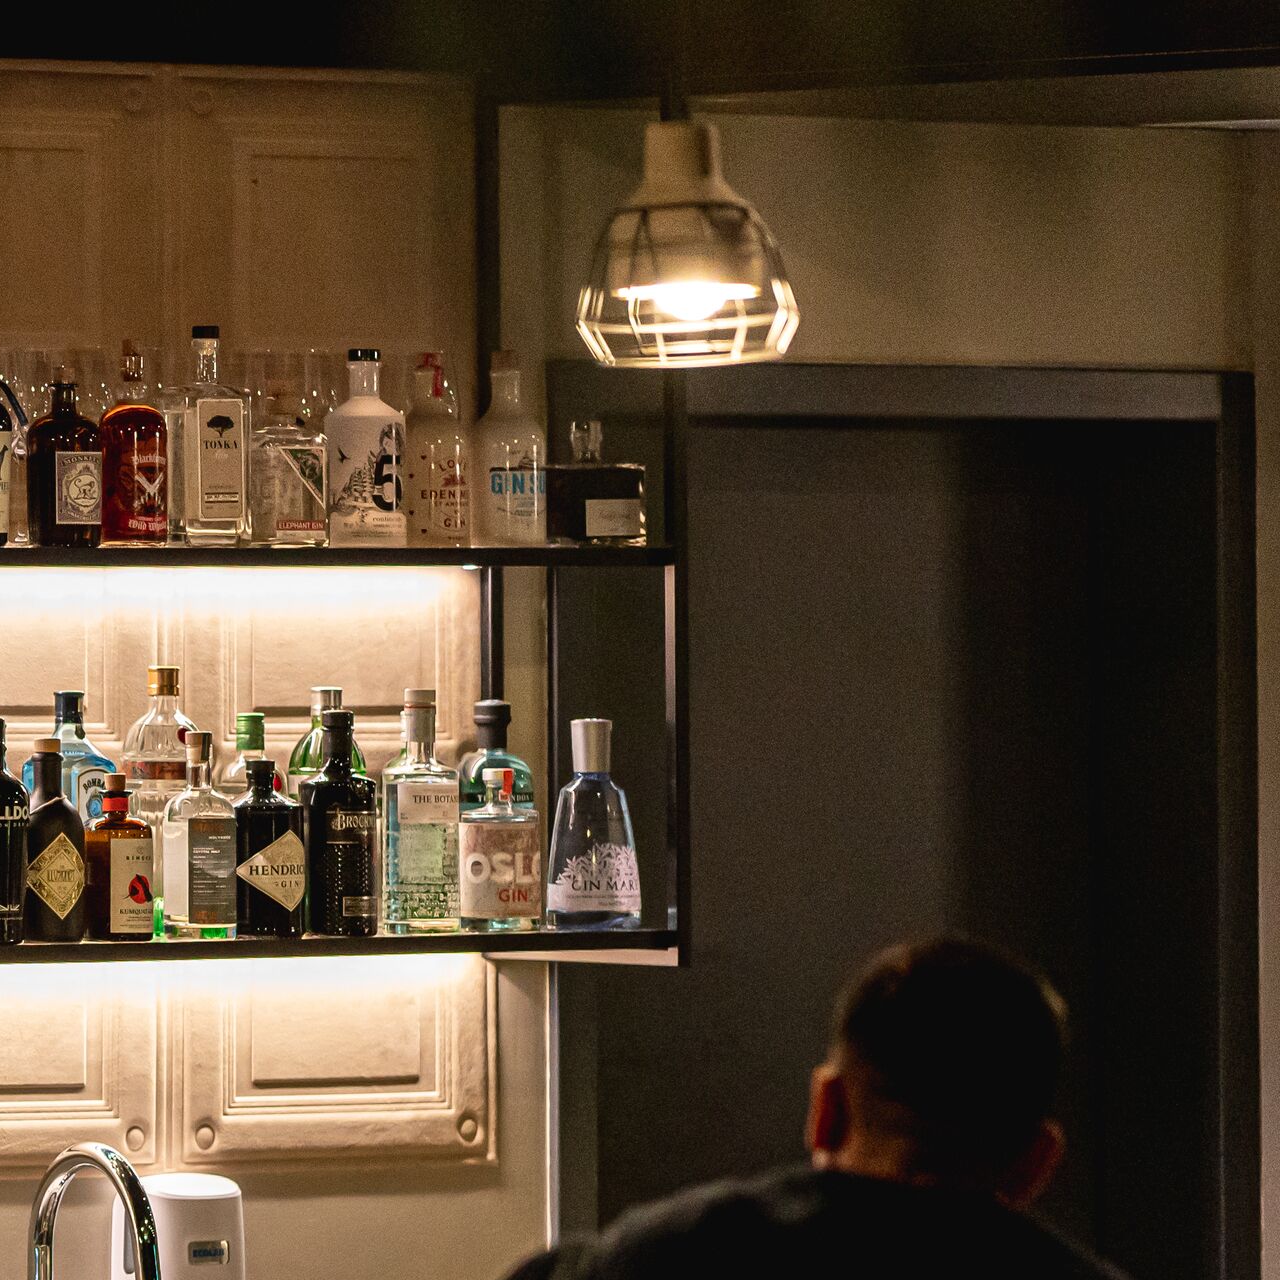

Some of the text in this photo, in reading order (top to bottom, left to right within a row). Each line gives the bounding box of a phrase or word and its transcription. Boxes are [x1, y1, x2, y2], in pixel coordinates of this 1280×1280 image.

[203, 440, 239, 450] TONKA
[371, 454, 403, 511] 5
[490, 471, 525, 495] GIN
[420, 489, 456, 500] EDEN
[278, 522, 324, 530] ELEPHANT GIN
[83, 778, 107, 793] BOMBA
[412, 795, 431, 804] THE
[571, 878, 602, 891] GIN
[498, 888, 529, 903] GIN
